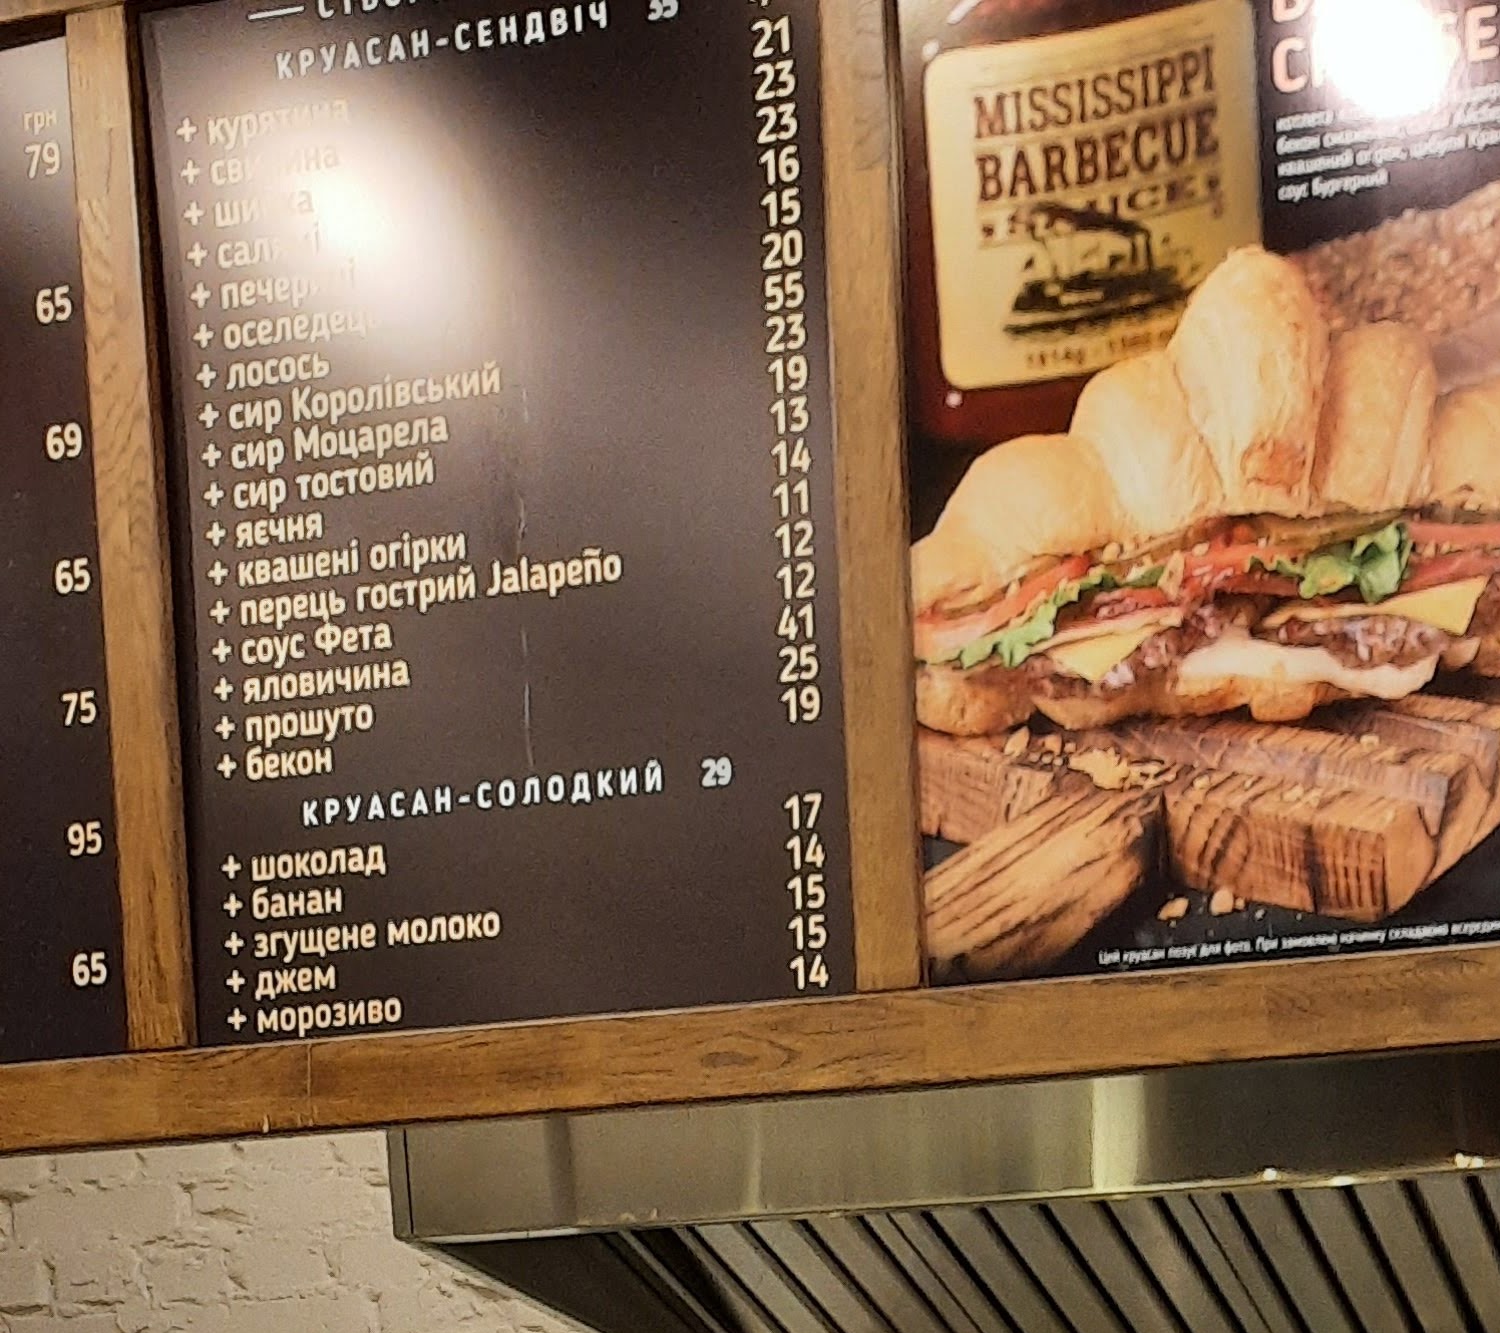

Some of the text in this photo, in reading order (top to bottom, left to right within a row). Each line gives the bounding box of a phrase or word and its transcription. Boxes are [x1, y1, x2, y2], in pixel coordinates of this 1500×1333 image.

[274, 2, 608, 80] КРУАСАН-СЕНДВІЧ
[751, 18, 790, 58] 21
[974, 45, 1214, 139] MISSISSIPPI
[25, 141, 60, 177] 79
[758, 145, 800, 183] 16
[975, 102, 1223, 203] BARBECUE
[36, 285, 72, 324] 65
[764, 271, 805, 311] 55
[226, 352, 332, 390] лосось
[768, 355, 808, 393] 19
[228, 361, 501, 434] сир Королівський
[46, 422, 82, 460] 69
[231, 415, 449, 474] сир Моцарела
[771, 439, 812, 476] 14
[233, 449, 434, 513] сир тостовий
[236, 513, 323, 548] яєчня
[54, 558, 91, 594] 65
[237, 532, 468, 587] квашені огірки
[240, 549, 622, 632] перець гострий Jalapeño
[777, 604, 814, 641] 41
[241, 619, 393, 669] соус Фета
[243, 657, 411, 704] яловичина
[62, 690, 97, 726] 75
[245, 703, 373, 744] прошуто
[246, 745, 333, 781] бекон
[301, 757, 732, 826] КРУАСАН-СОЛОДКИЙ 29
[784, 792, 822, 830] 17
[67, 821, 102, 856] 95
[251, 844, 386, 882] шоколад
[252, 886, 342, 918] банан
[254, 911, 500, 962] згущене молоко
[72, 951, 107, 987] 65
[254, 964, 336, 1001] джем
[257, 997, 402, 1038] морозиво
